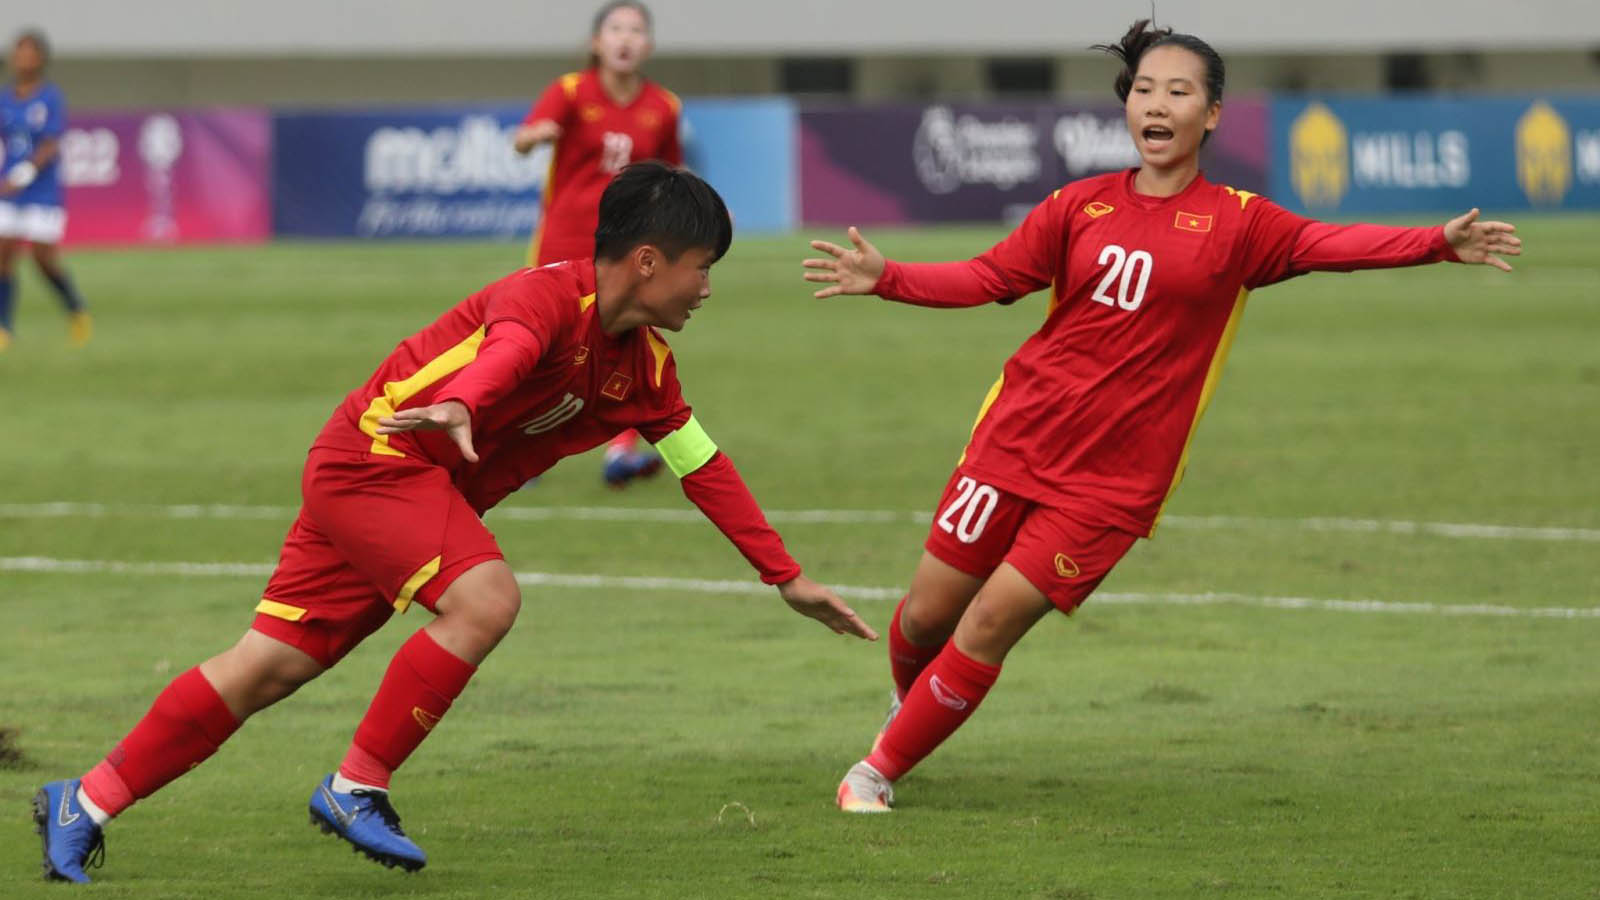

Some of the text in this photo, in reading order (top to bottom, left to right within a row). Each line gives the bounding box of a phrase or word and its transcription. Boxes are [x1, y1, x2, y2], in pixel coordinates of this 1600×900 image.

[1353, 130, 1470, 188] MILLS
[1091, 244, 1153, 311] 20
[518, 392, 584, 434] 10
[937, 476, 999, 544] 20
